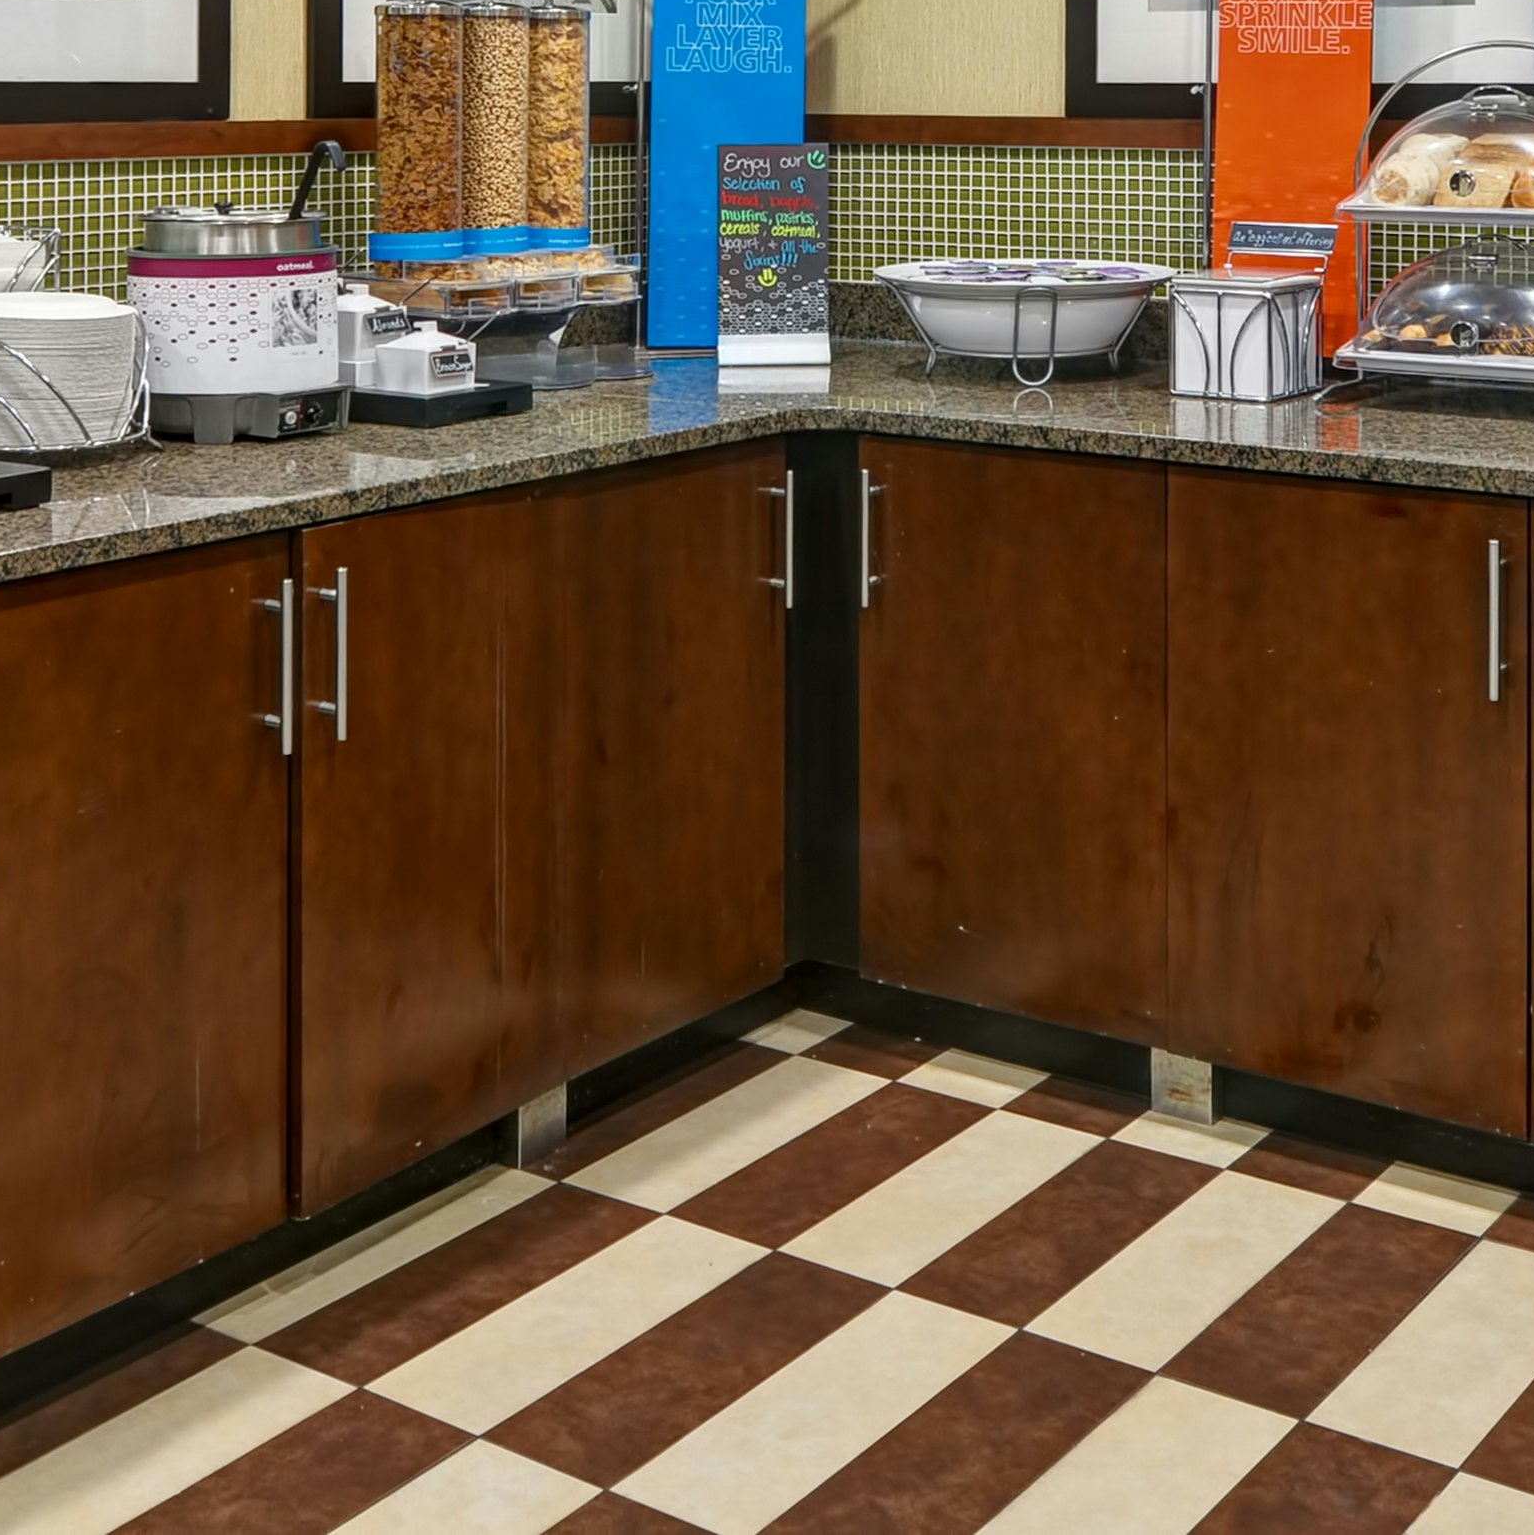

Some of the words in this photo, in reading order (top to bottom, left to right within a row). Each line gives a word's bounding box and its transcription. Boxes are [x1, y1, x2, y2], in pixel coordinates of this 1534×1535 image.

[696, 2, 764, 27] MIX
[1219, 1, 1373, 29] SPRINKLE
[676, 24, 783, 50] LAYER
[1237, 25, 1351, 54] SMILE.
[666, 46, 792, 73] LAUGH.
[723, 152, 771, 178] Enjoy
[779, 155, 805, 169] our
[790, 176, 807, 194] of
